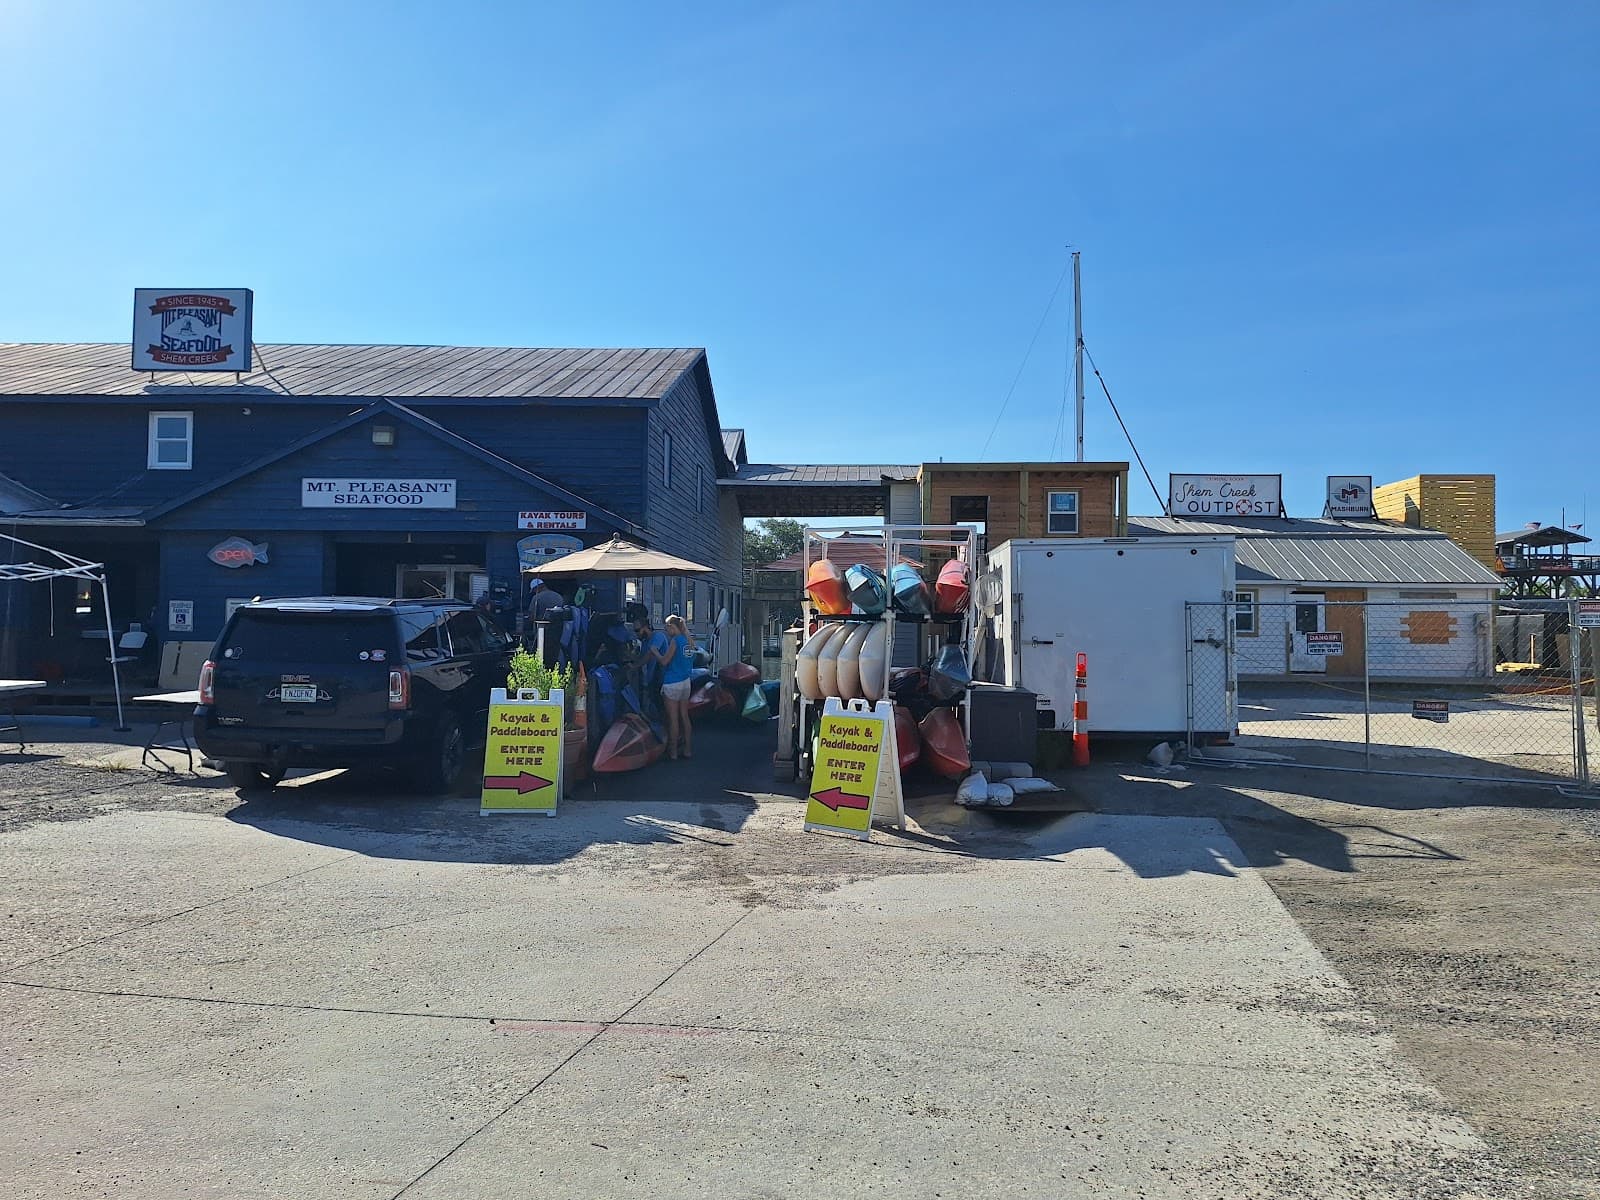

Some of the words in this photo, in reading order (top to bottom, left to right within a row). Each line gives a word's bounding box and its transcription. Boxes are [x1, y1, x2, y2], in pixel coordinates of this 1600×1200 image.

[167, 296, 195, 306] SINCE
[198, 297, 217, 306] 1945
[161, 334, 221, 352] SEAFOOD
[161, 353, 186, 363] SHEM
[188, 354, 218, 364] CREEK
[306, 482, 340, 492] MT.
[348, 482, 452, 493] PLEASANT
[1175, 482, 1214, 503] Shem
[1219, 482, 1257, 498] Creek
[334, 494, 424, 505] SEAFOOD
[1187, 499, 1275, 515] OUTPOST
[527, 521, 534, 529] &
[536, 521, 577, 529] RENTALS
[215, 550, 254, 561] OPEN
[281, 674, 310, 683] GMC
[500, 712, 536, 725] Kayak
[540, 713, 550, 723] &
[490, 726, 558, 737] Paddleboard
[829, 724, 860, 738] Kayak
[864, 727, 873, 738] &
[500, 745, 545, 754] ENTER
[820, 737, 879, 753] Paddleboard
[505, 756, 543, 766] HERE
[827, 758, 866, 771] ENTER
[830, 771, 863, 783] HERE
